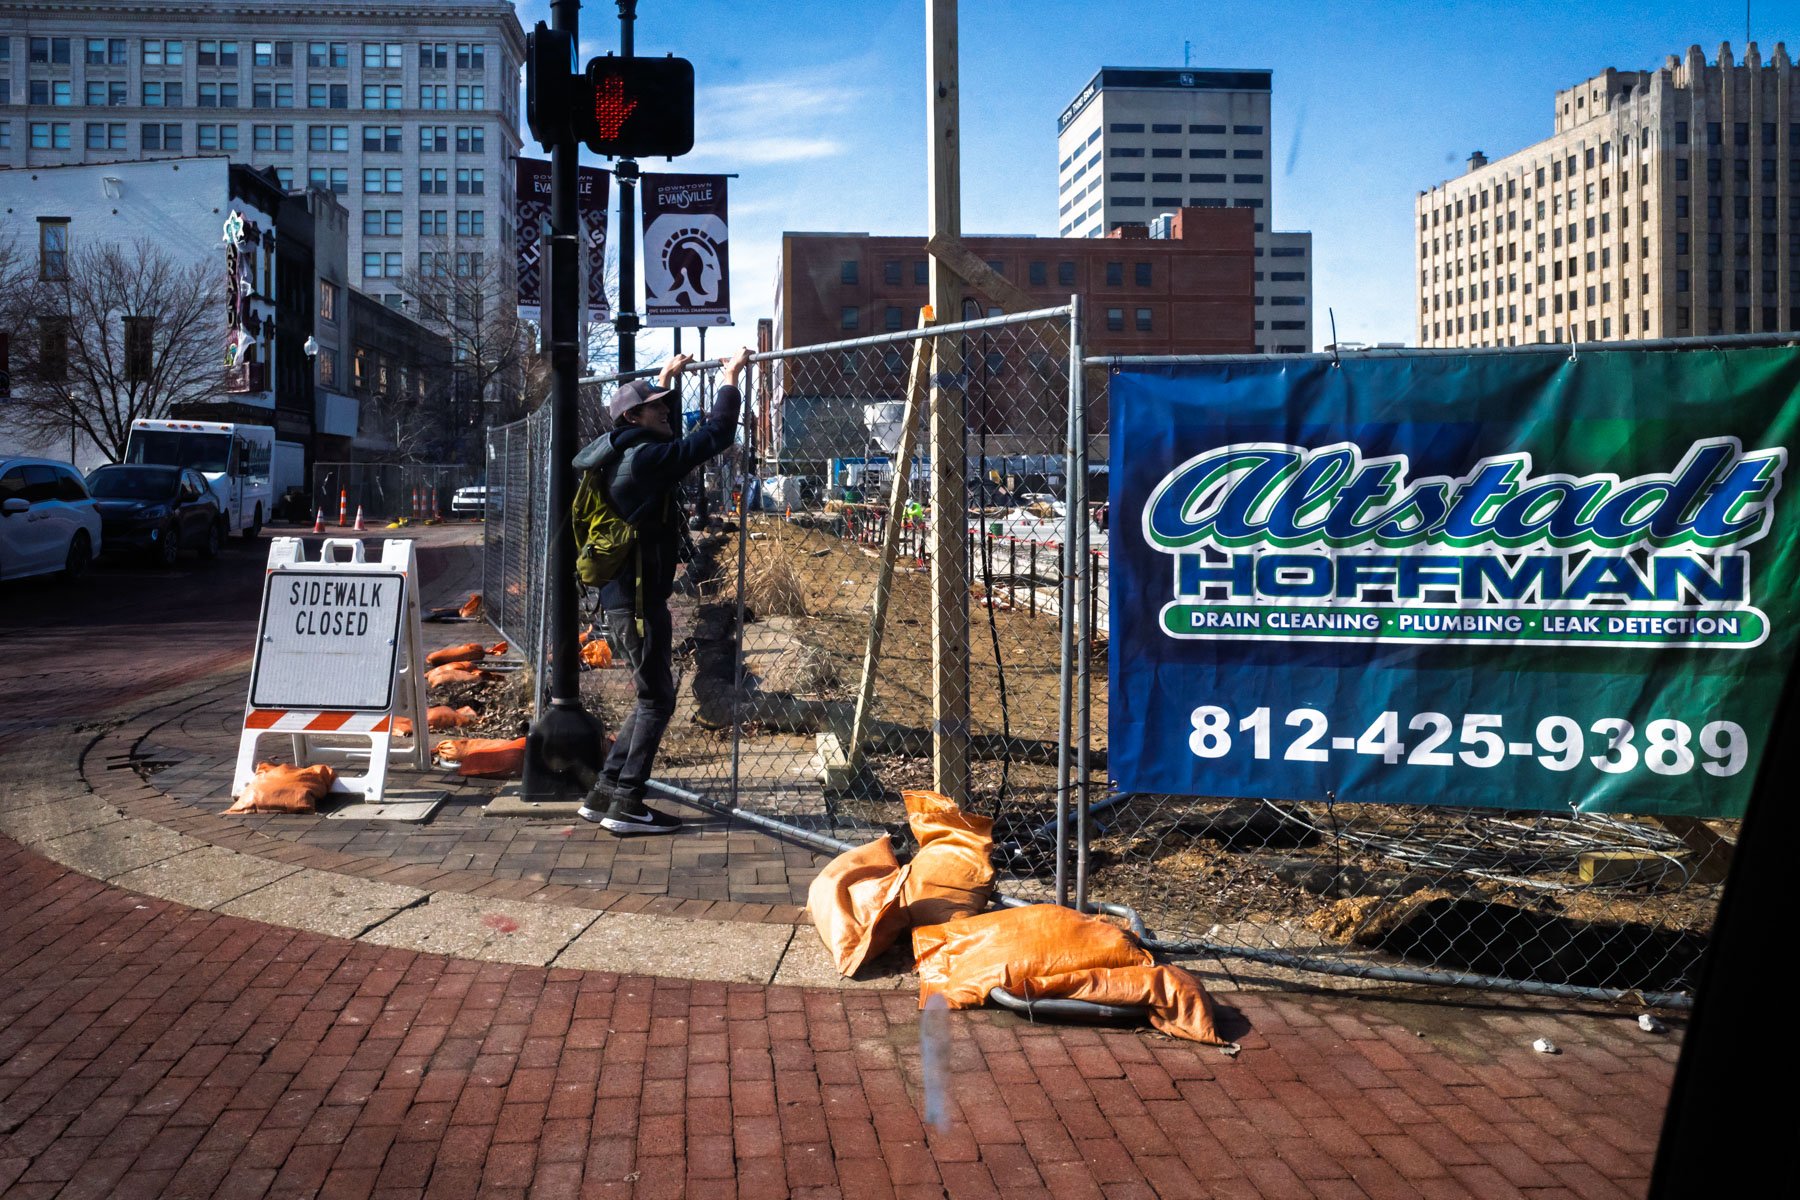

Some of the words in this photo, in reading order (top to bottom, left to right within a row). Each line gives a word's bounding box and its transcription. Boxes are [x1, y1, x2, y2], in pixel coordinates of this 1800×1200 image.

[534, 181, 593, 195] EVALE
[658, 182, 712, 192] DOWNTOWN
[1144, 438, 1783, 550] Altstadt
[1177, 553, 1746, 602] HOFFMAN
[290, 581, 382, 607] SIDEWALK
[296, 611, 368, 636] CLOSED
[1190, 611, 1260, 630] DRAIN
[1267, 611, 1380, 632] CLEANING
[1398, 613, 1522, 633] PLUMBING
[1542, 616, 1600, 634] LEAK
[1608, 616, 1739, 636] DETECTION
[1188, 705, 1749, 778] 812-425-9389
